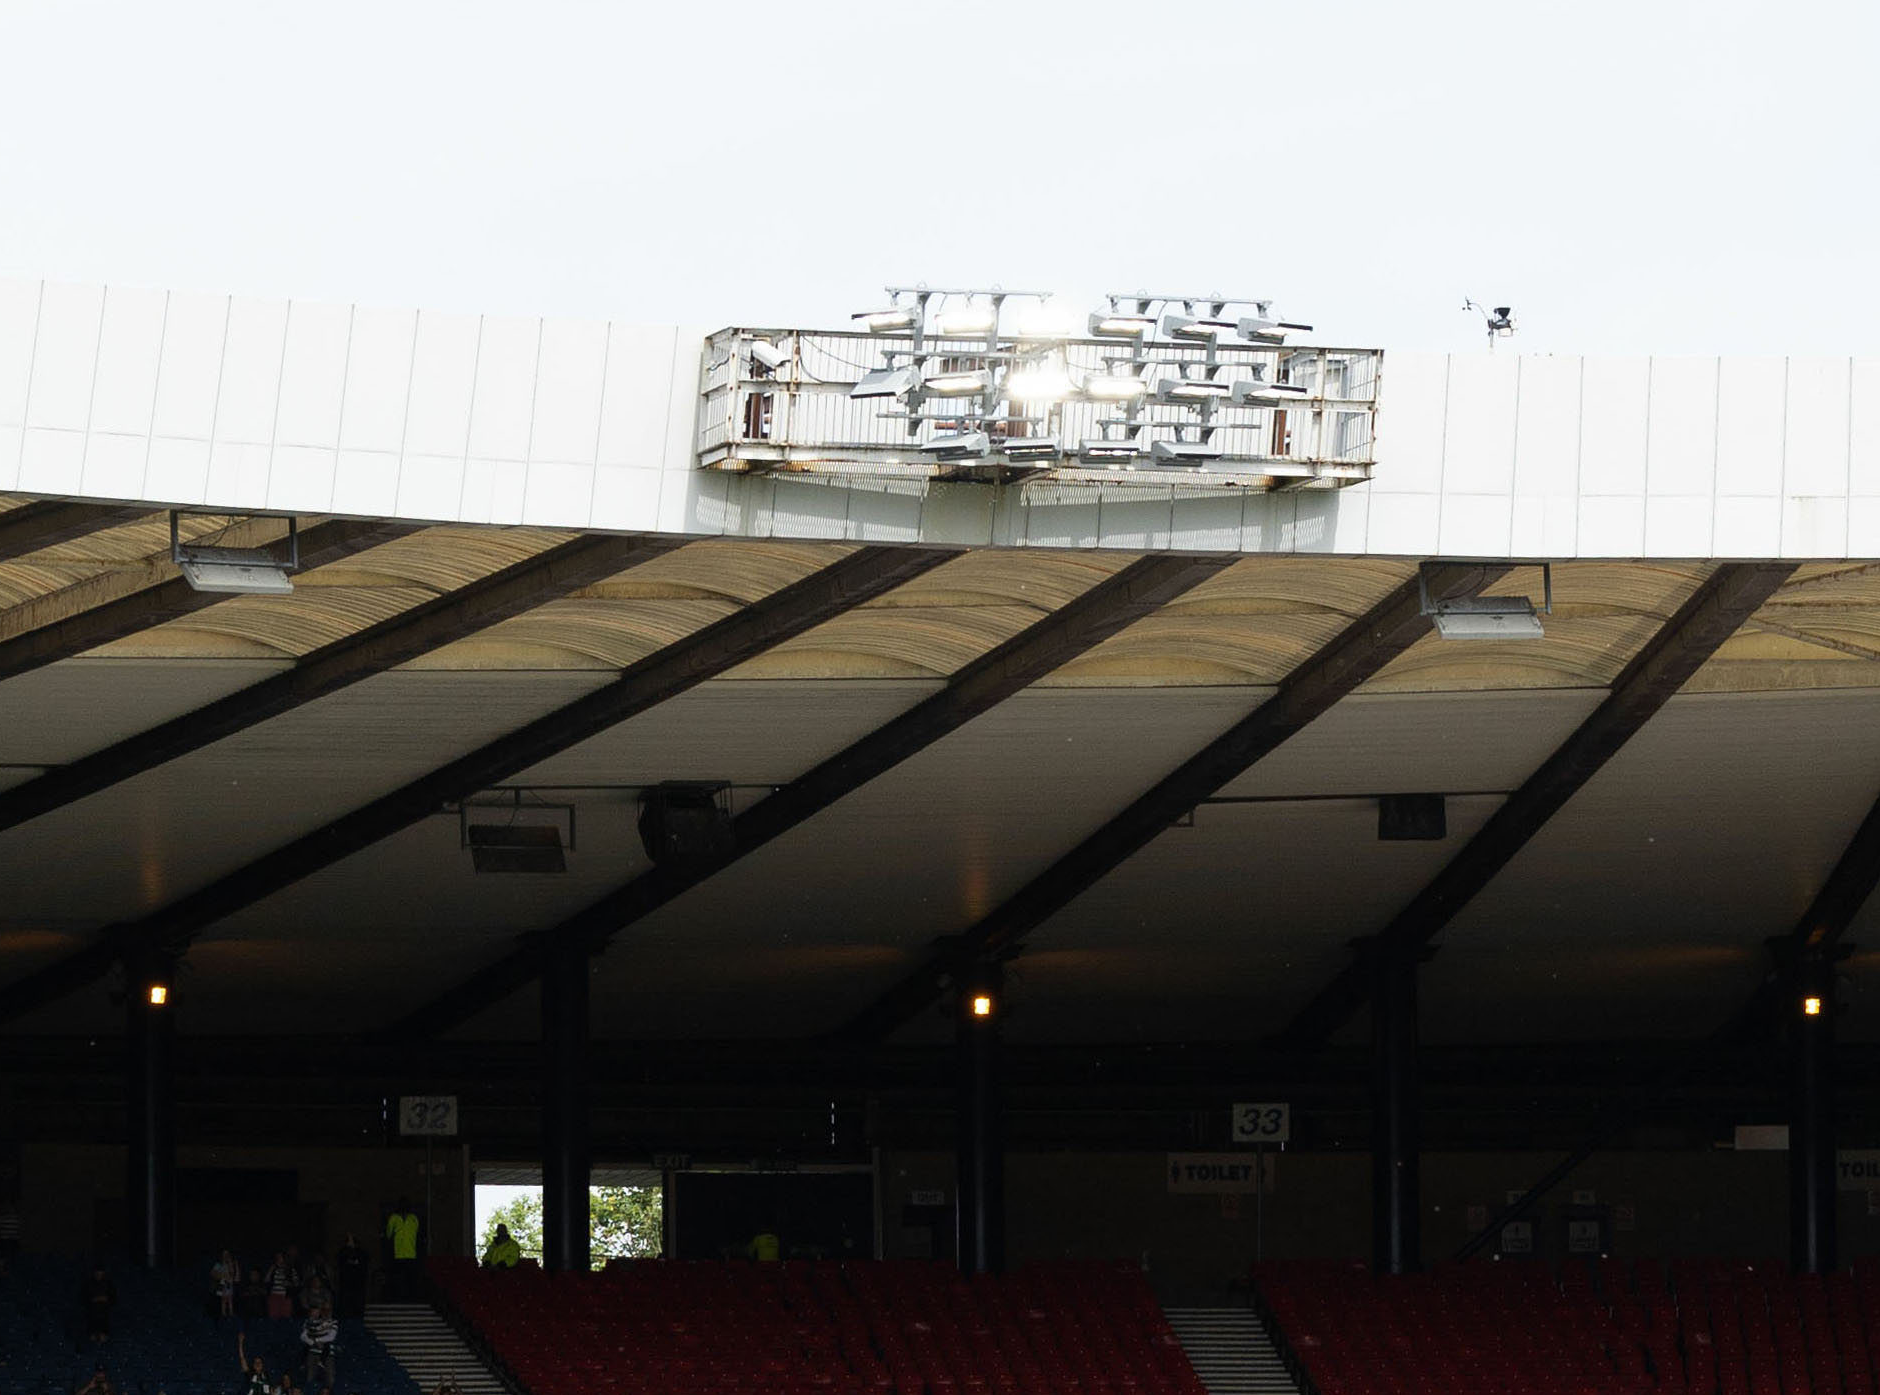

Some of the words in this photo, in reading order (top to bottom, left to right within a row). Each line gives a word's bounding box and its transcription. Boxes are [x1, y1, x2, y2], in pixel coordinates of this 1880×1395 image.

[407, 1102, 451, 1129] 32
[1239, 1108, 1284, 1135] 33
[653, 1154, 691, 1169] EXIT
[1185, 1164, 1252, 1181] TOILET
